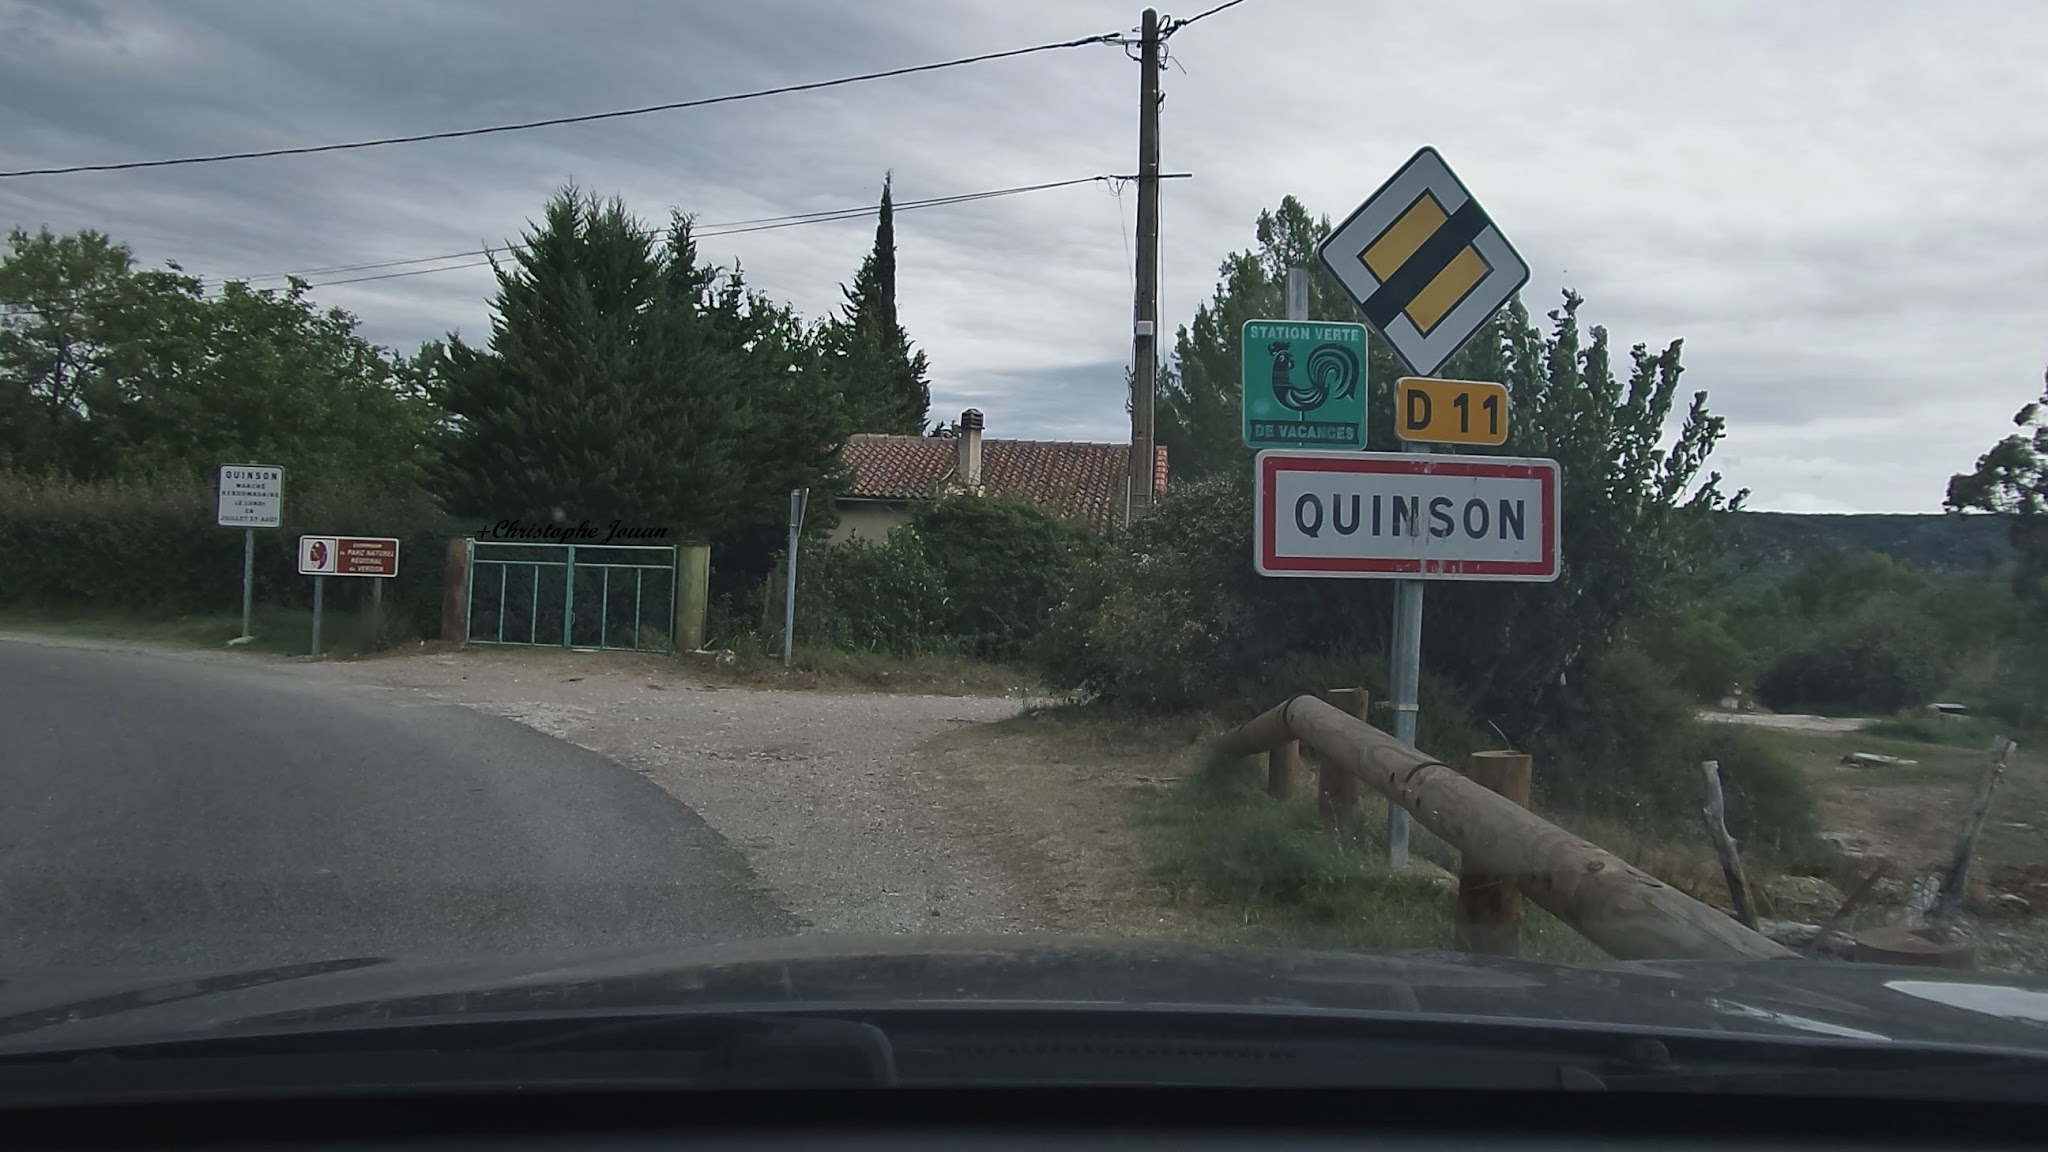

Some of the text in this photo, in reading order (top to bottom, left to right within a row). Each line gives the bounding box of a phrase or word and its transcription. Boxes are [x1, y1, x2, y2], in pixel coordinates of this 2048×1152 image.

[1251, 326, 1360, 342] STATION VERTE
[1406, 388, 1498, 435] D 11
[1254, 426, 1355, 440] DE VACANCES
[225, 471, 278, 480] QUINSON
[1294, 492, 1526, 541] QUINSON
